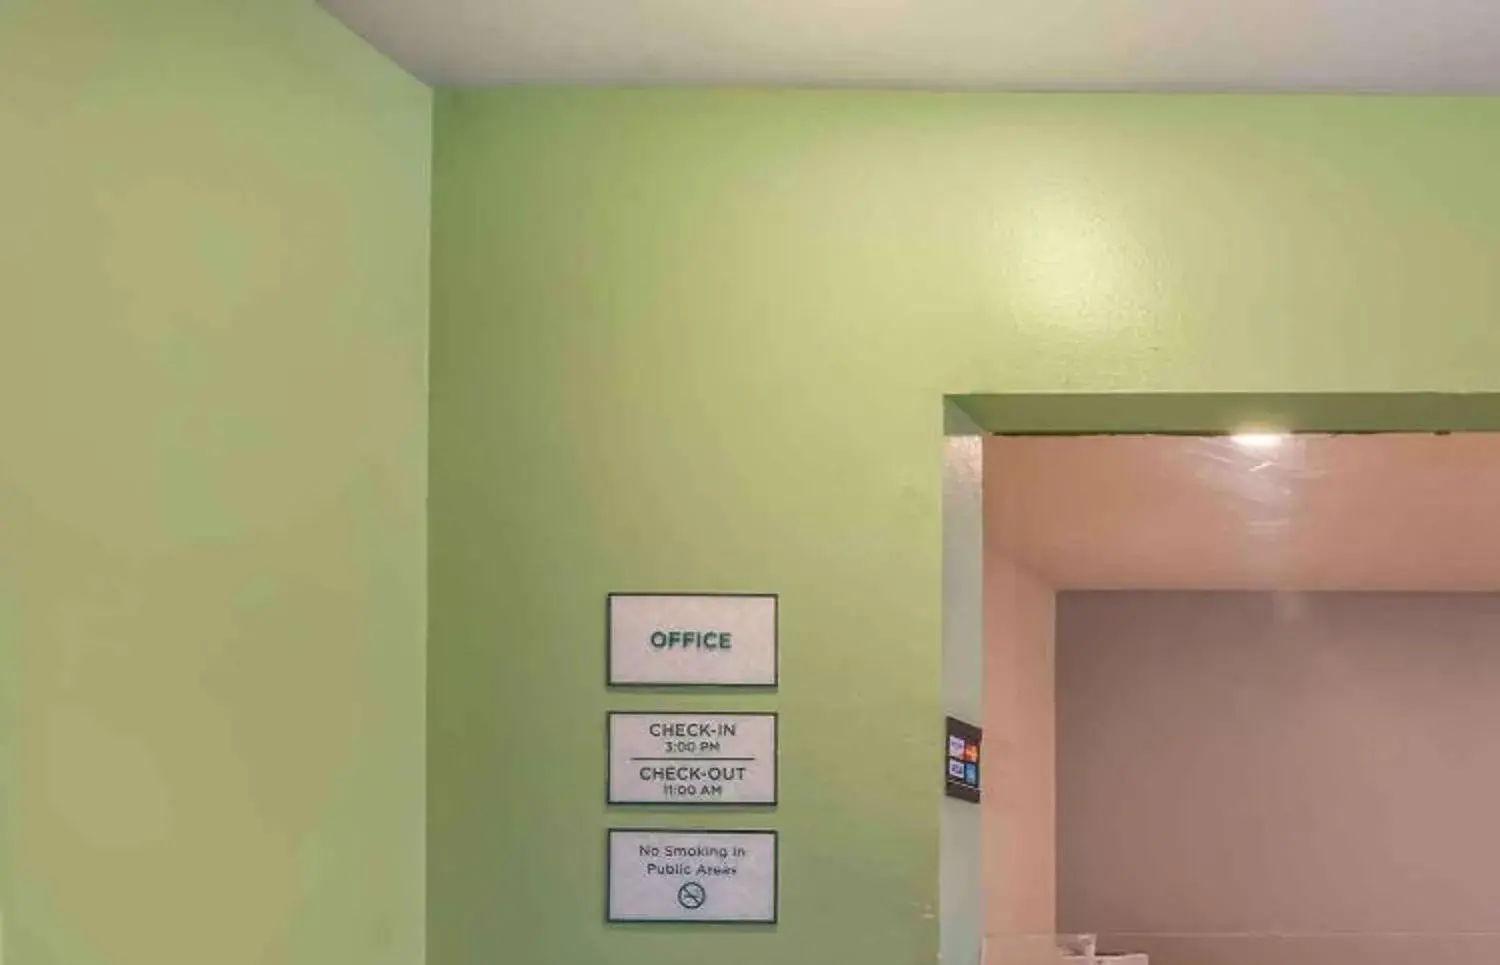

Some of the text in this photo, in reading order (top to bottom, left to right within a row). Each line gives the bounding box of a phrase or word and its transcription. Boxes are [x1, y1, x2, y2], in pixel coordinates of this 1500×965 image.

[650, 631, 732, 649] OFFICE
[649, 723, 736, 738] CHECK-IN
[665, 741, 720, 752] 3:00 PM
[639, 767, 746, 781] CHECK-OUT
[663, 785, 722, 796] 11:00 AM
[639, 845, 659, 857] No
[664, 845, 728, 859] Smoking
[647, 863, 691, 876] Public
